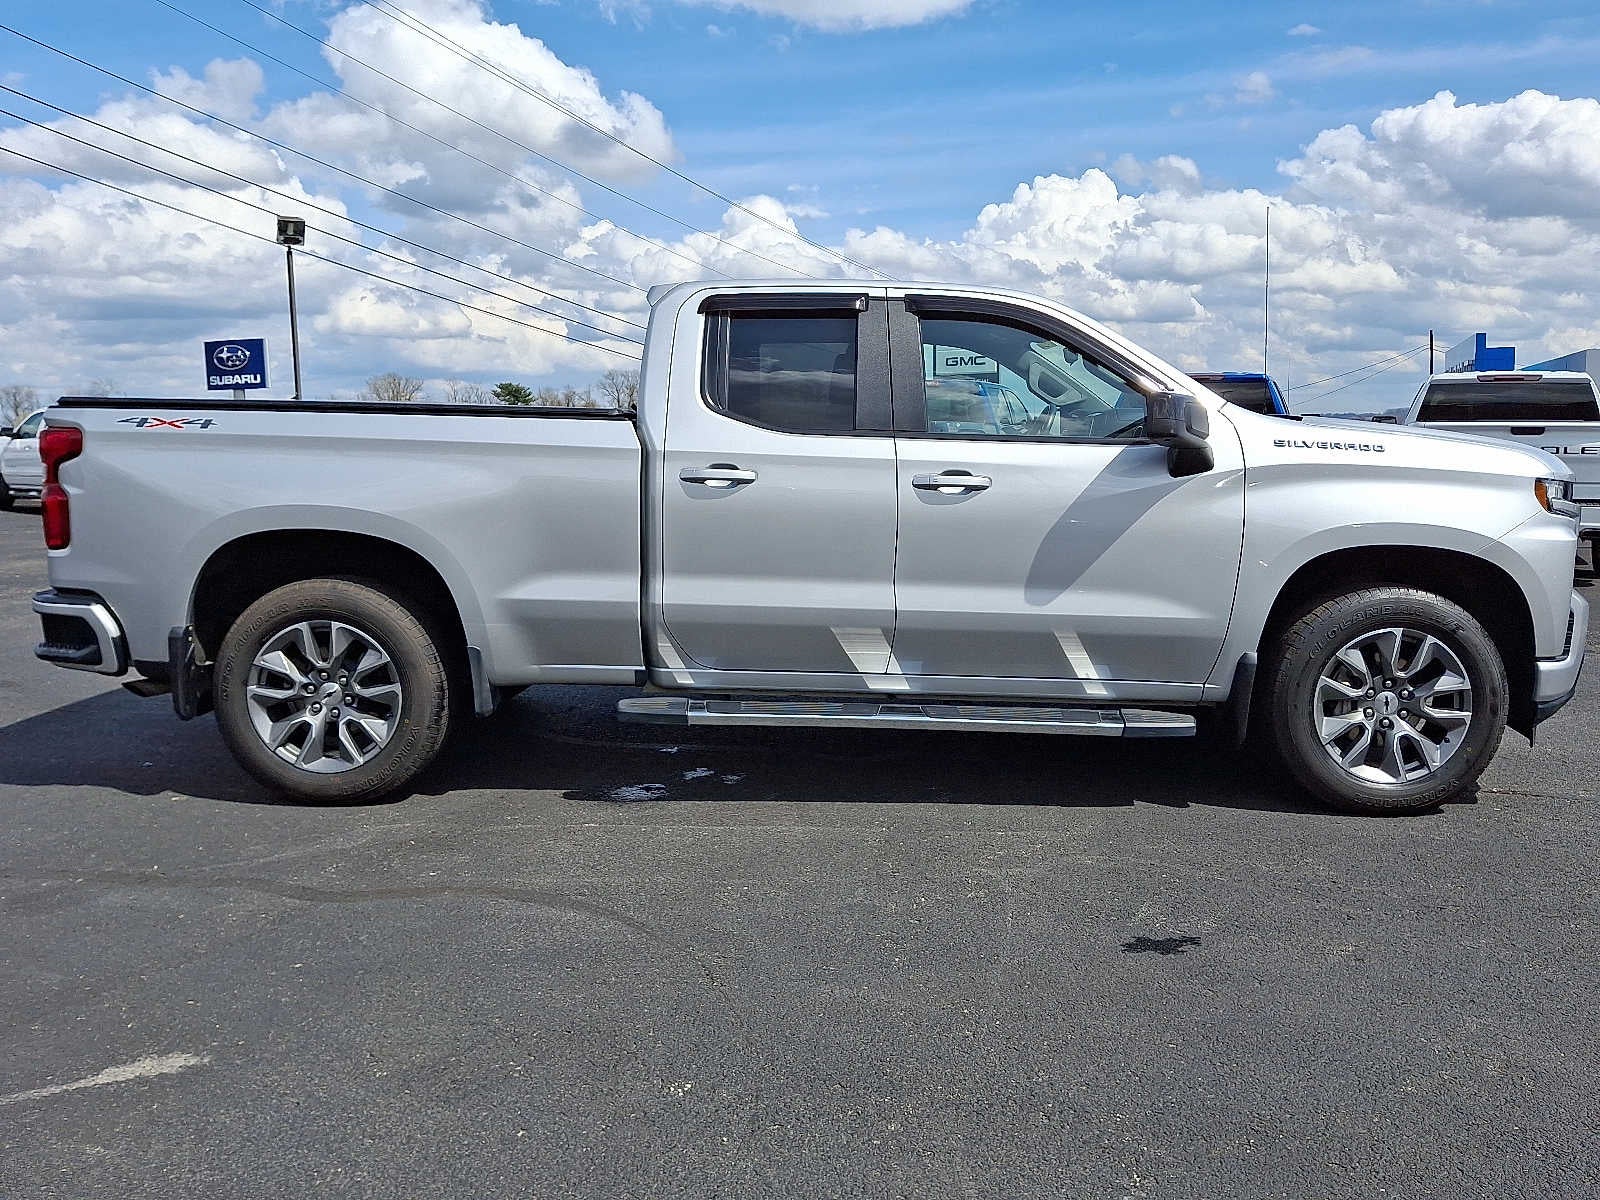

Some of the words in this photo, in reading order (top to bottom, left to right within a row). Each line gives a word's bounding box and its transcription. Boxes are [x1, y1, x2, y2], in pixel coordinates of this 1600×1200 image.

[945, 356, 986, 367] GMC
[209, 374, 261, 386] SUBARU
[1273, 439, 1385, 453] SILVERADO
